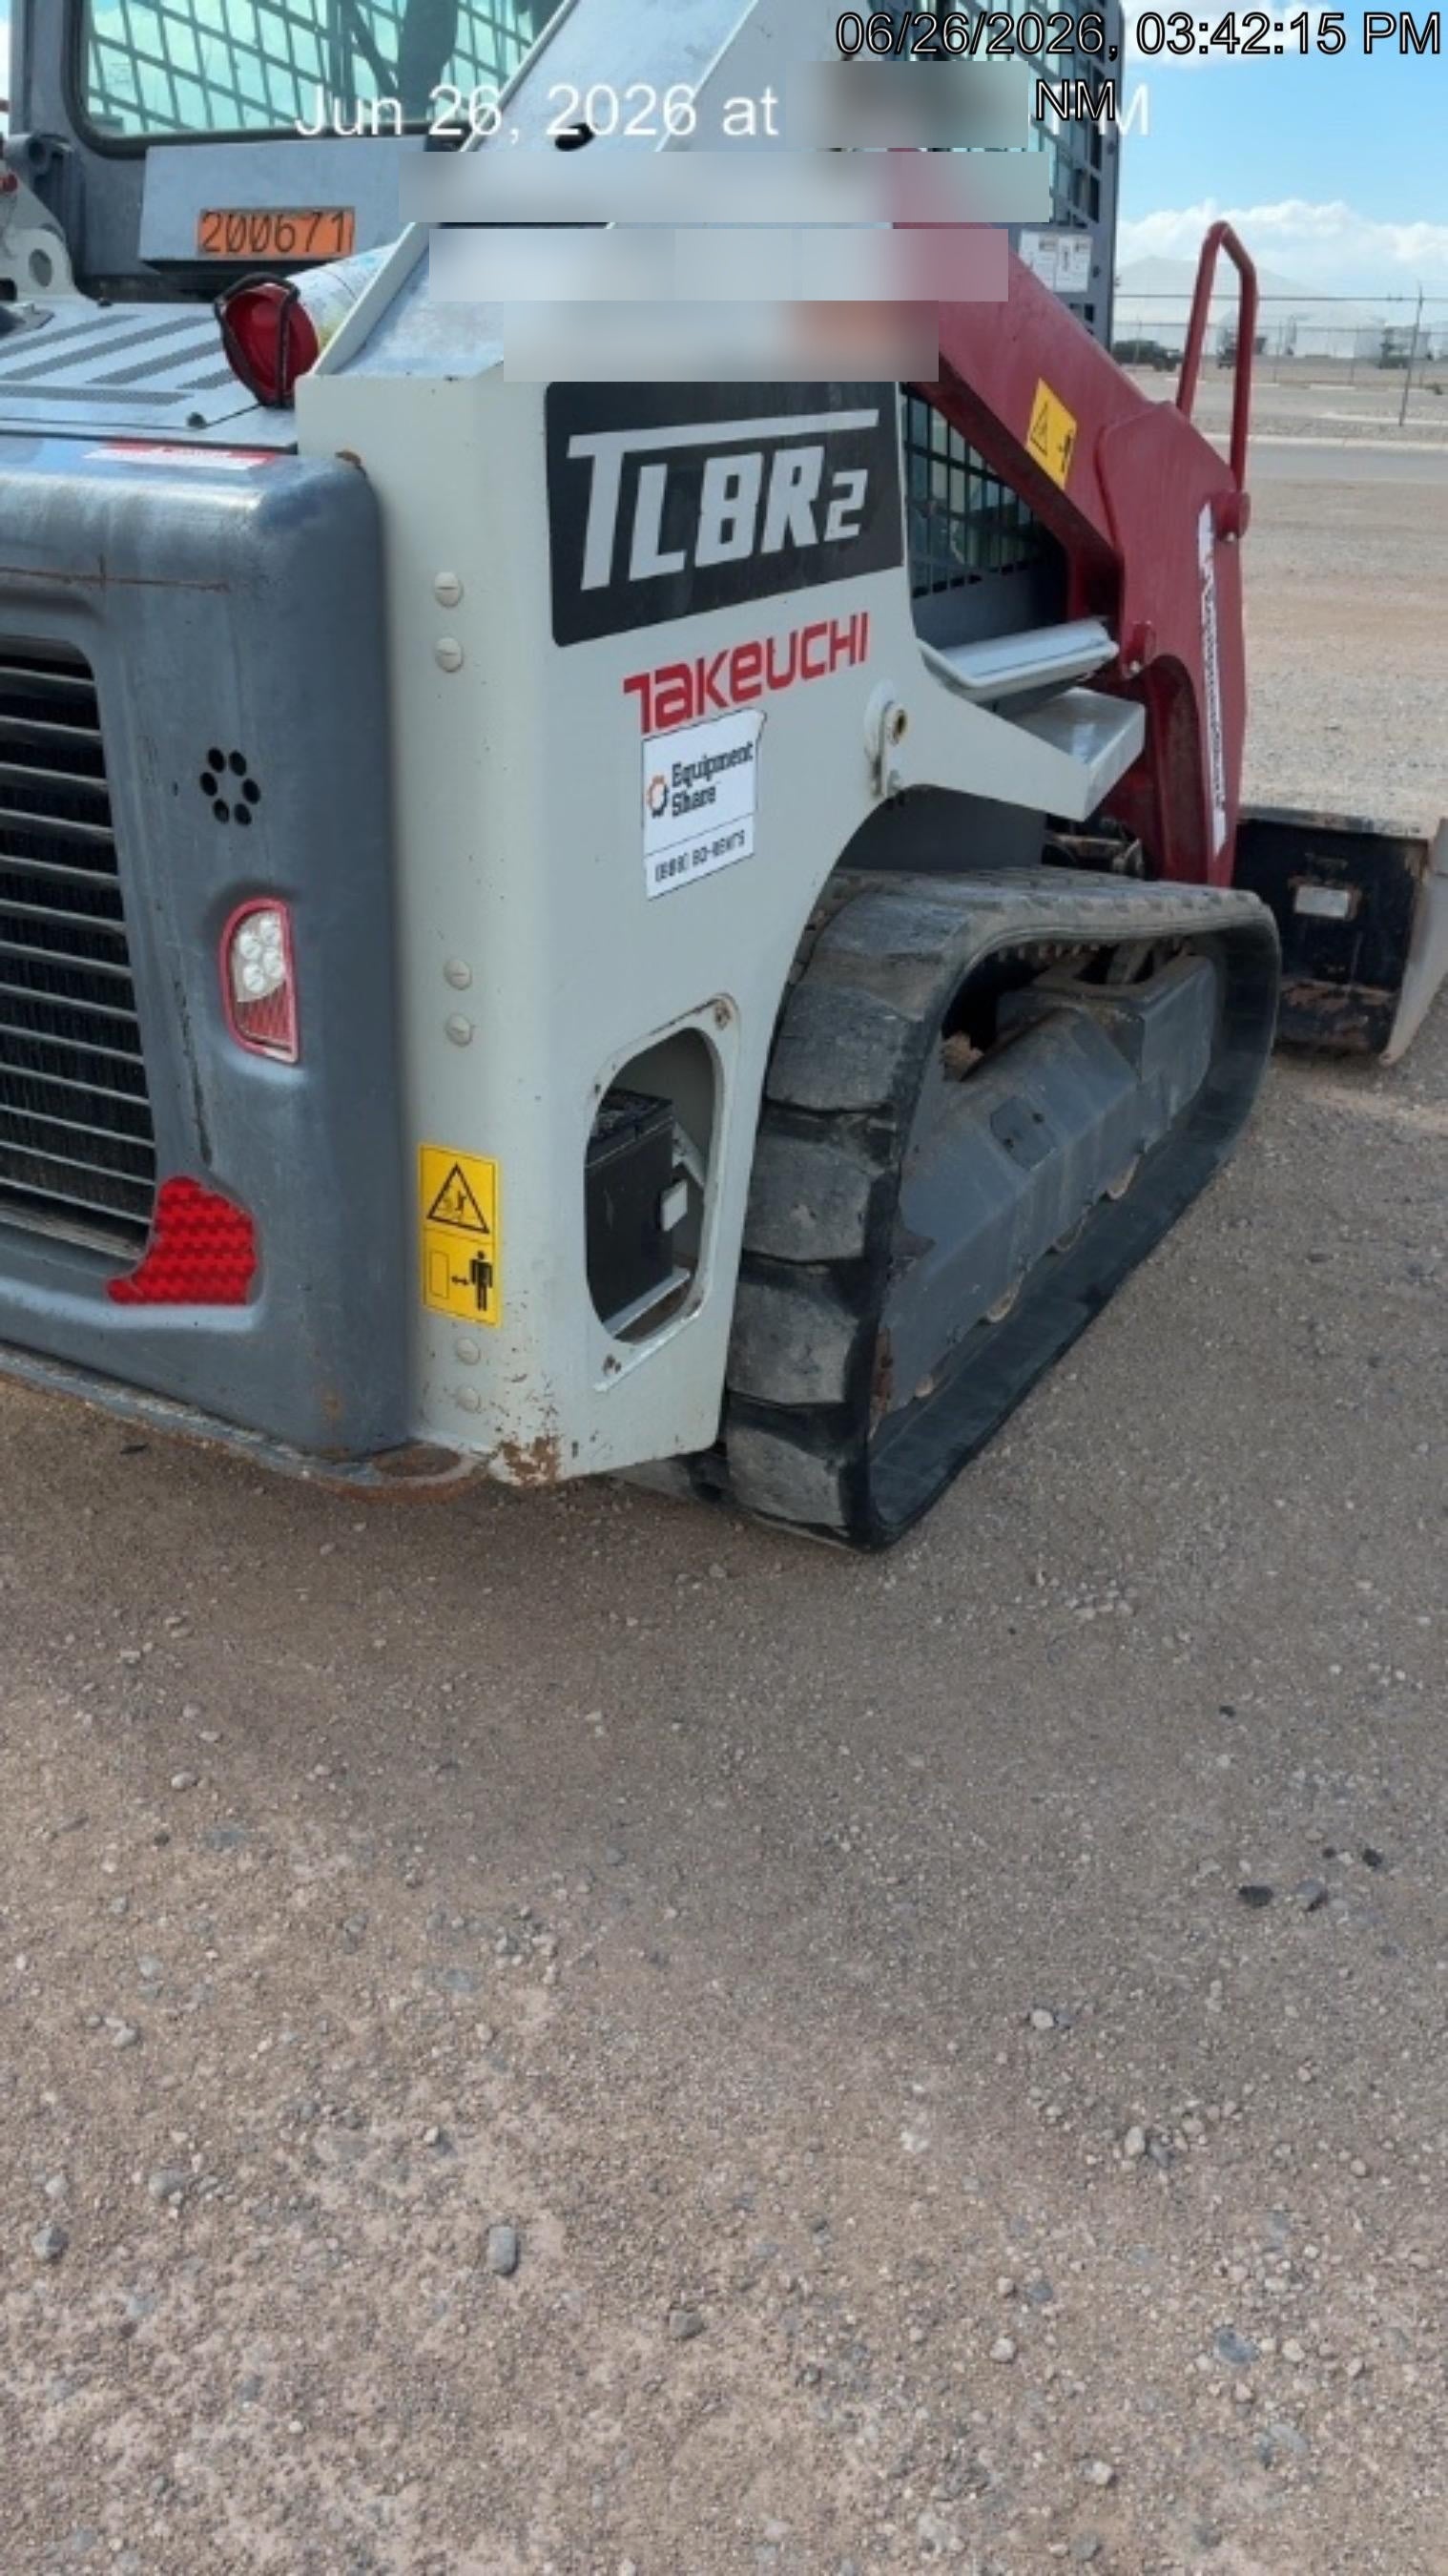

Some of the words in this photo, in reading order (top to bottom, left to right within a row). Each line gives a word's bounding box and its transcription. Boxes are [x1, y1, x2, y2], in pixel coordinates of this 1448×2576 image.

[201, 211, 344, 254] 200671
[672, 741, 754, 789] Equipment
[672, 786, 716, 818] Share
